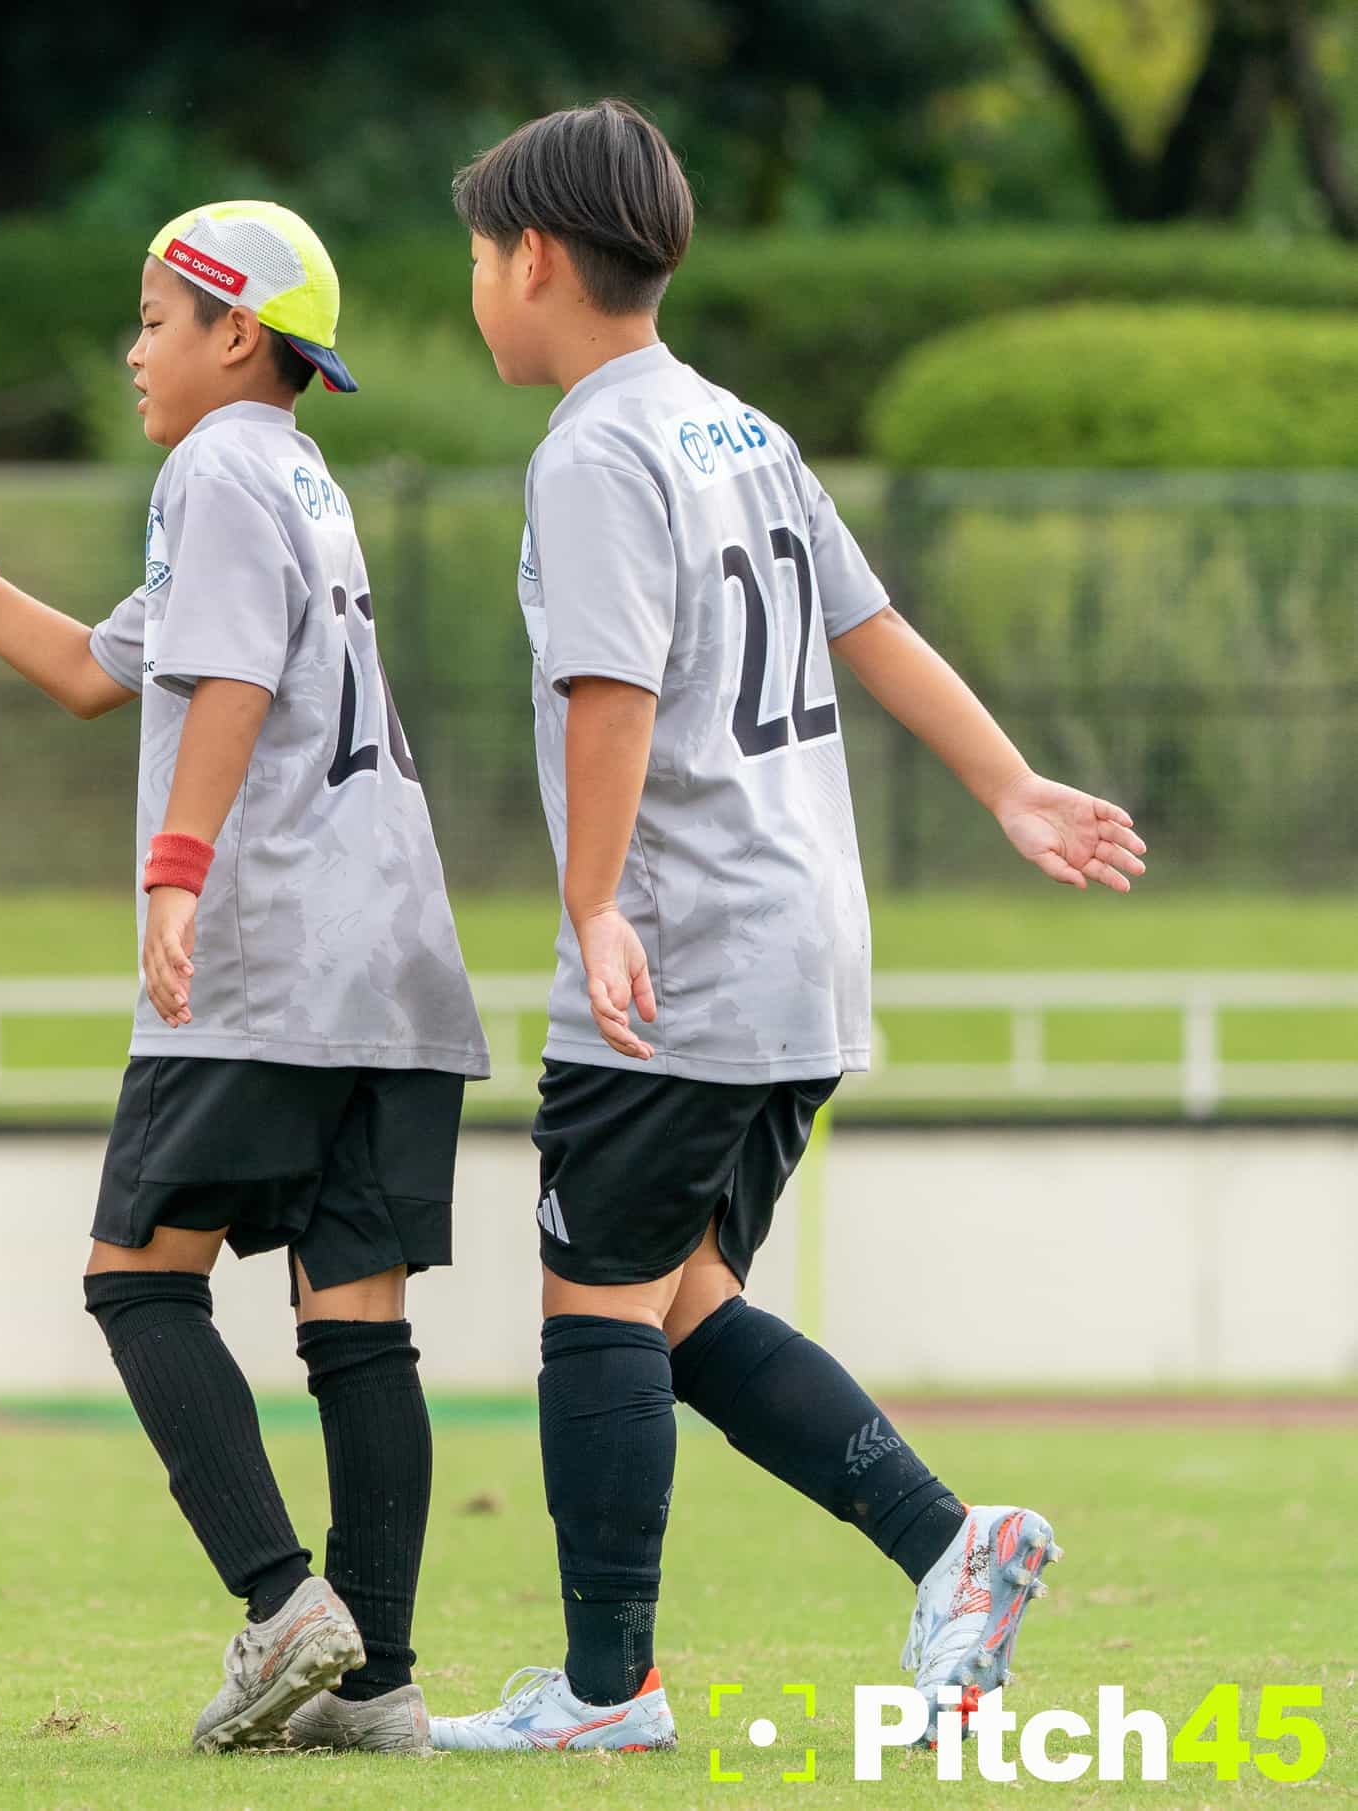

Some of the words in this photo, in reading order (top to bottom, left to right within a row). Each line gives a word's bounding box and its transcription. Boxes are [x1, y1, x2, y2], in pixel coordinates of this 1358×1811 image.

[172, 248, 192, 264] new
[192, 257, 235, 286] balance
[720, 525, 838, 759] 22
[847, 1436, 900, 1476] TABIO
